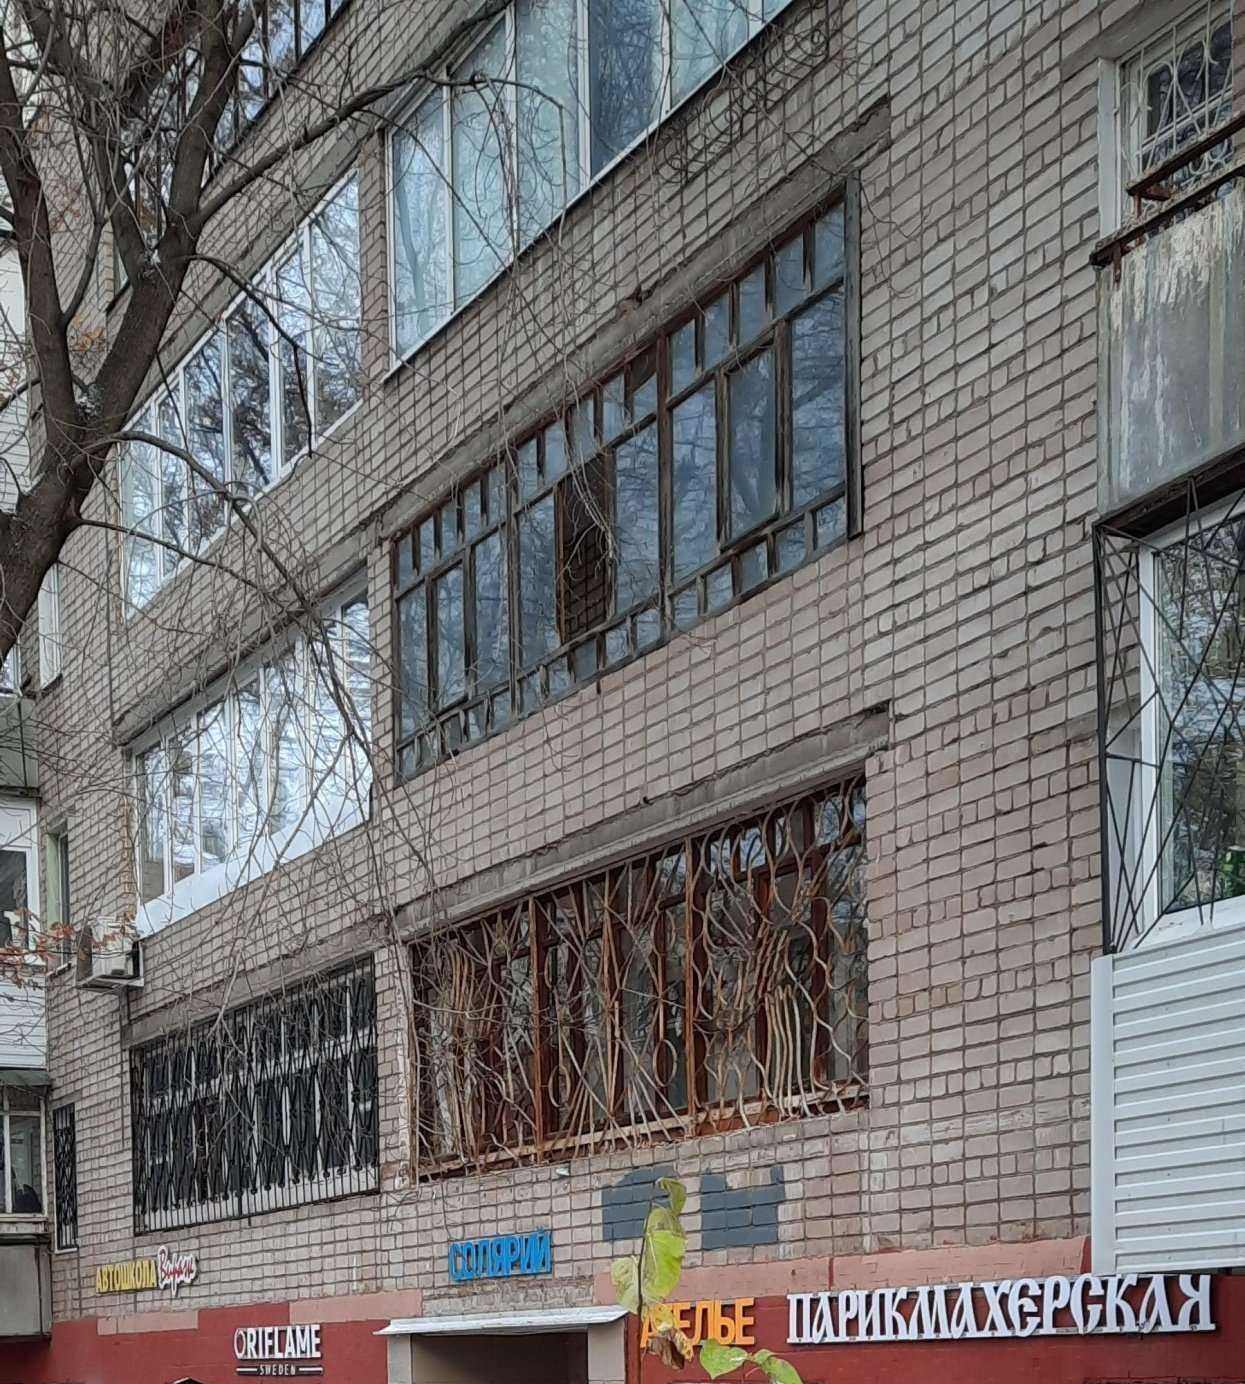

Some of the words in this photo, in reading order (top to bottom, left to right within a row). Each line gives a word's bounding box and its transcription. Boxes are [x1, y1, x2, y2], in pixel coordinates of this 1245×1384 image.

[449, 1226, 552, 1281] СОЛЯРИЙ
[96, 1259, 157, 1292] АВТОШКОЛА
[640, 1298, 755, 1349] АЕЛЬЕ
[787, 1272, 1216, 1343] ПАРИКМАХЕРСКАЯ
[234, 1325, 321, 1359] ORIFLAME
[259, 1364, 296, 1376] SWEDEN
